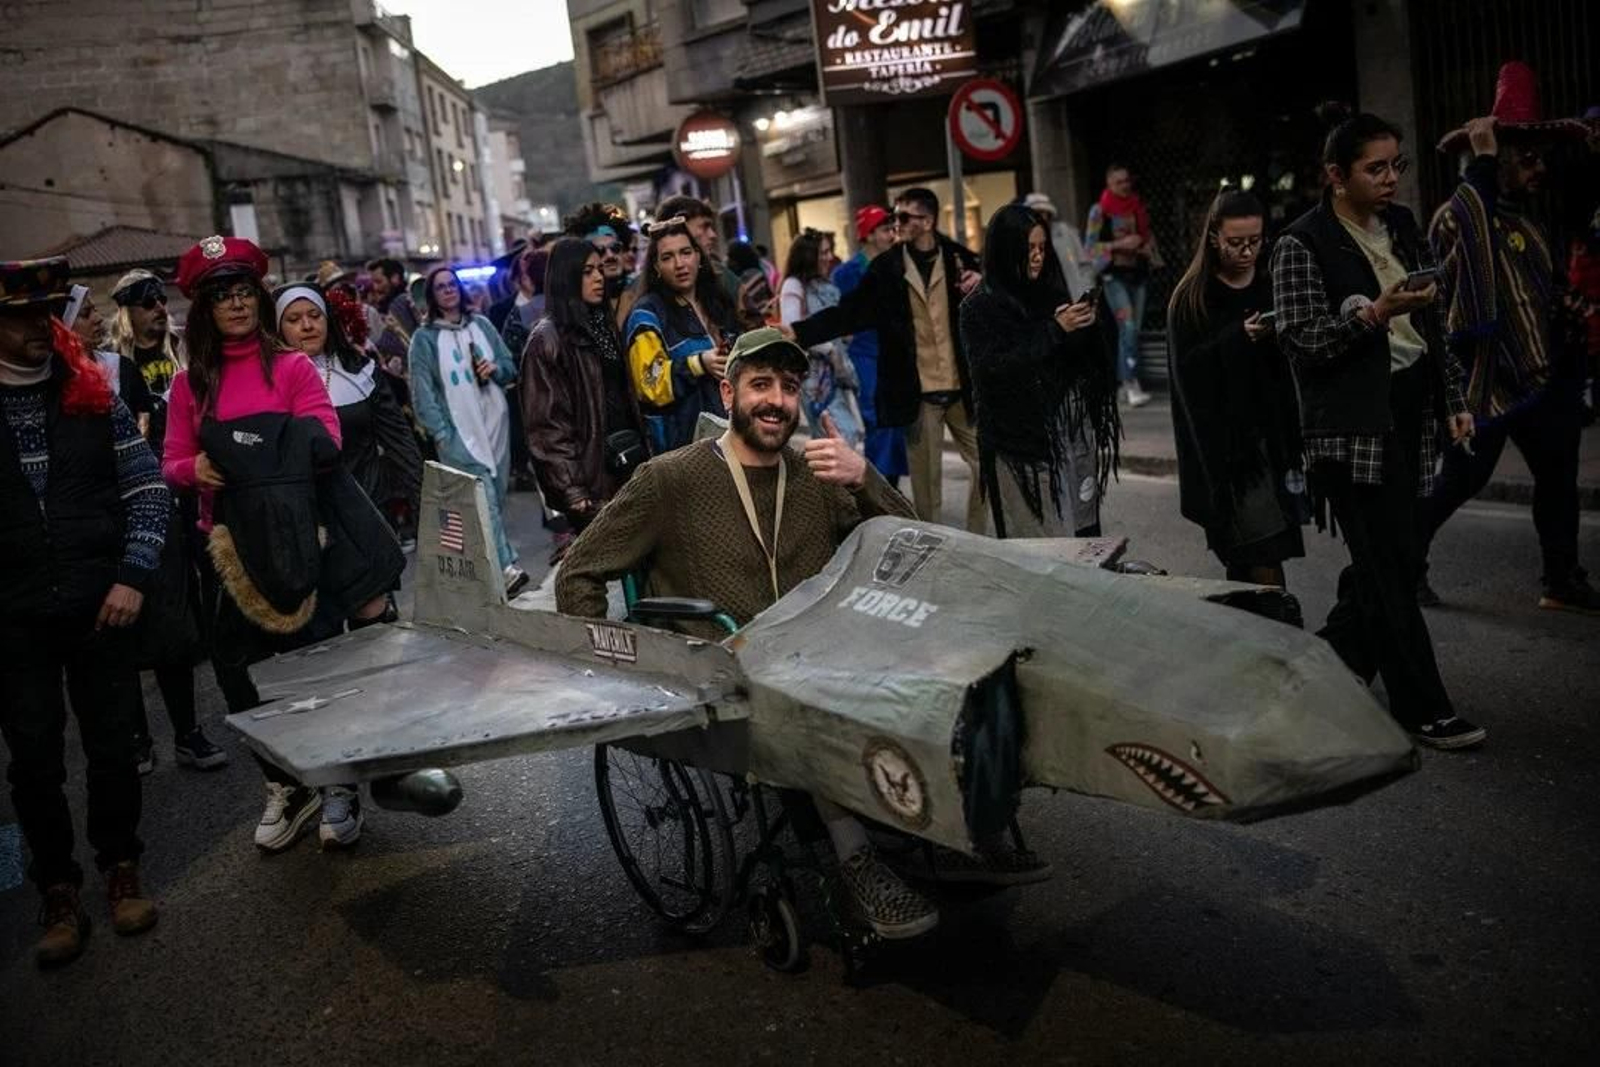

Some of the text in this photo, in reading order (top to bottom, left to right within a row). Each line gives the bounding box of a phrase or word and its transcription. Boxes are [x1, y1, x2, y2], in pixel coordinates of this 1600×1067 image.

[827, 3, 964, 48] do Emil
[837, 586, 940, 628] FORCE
